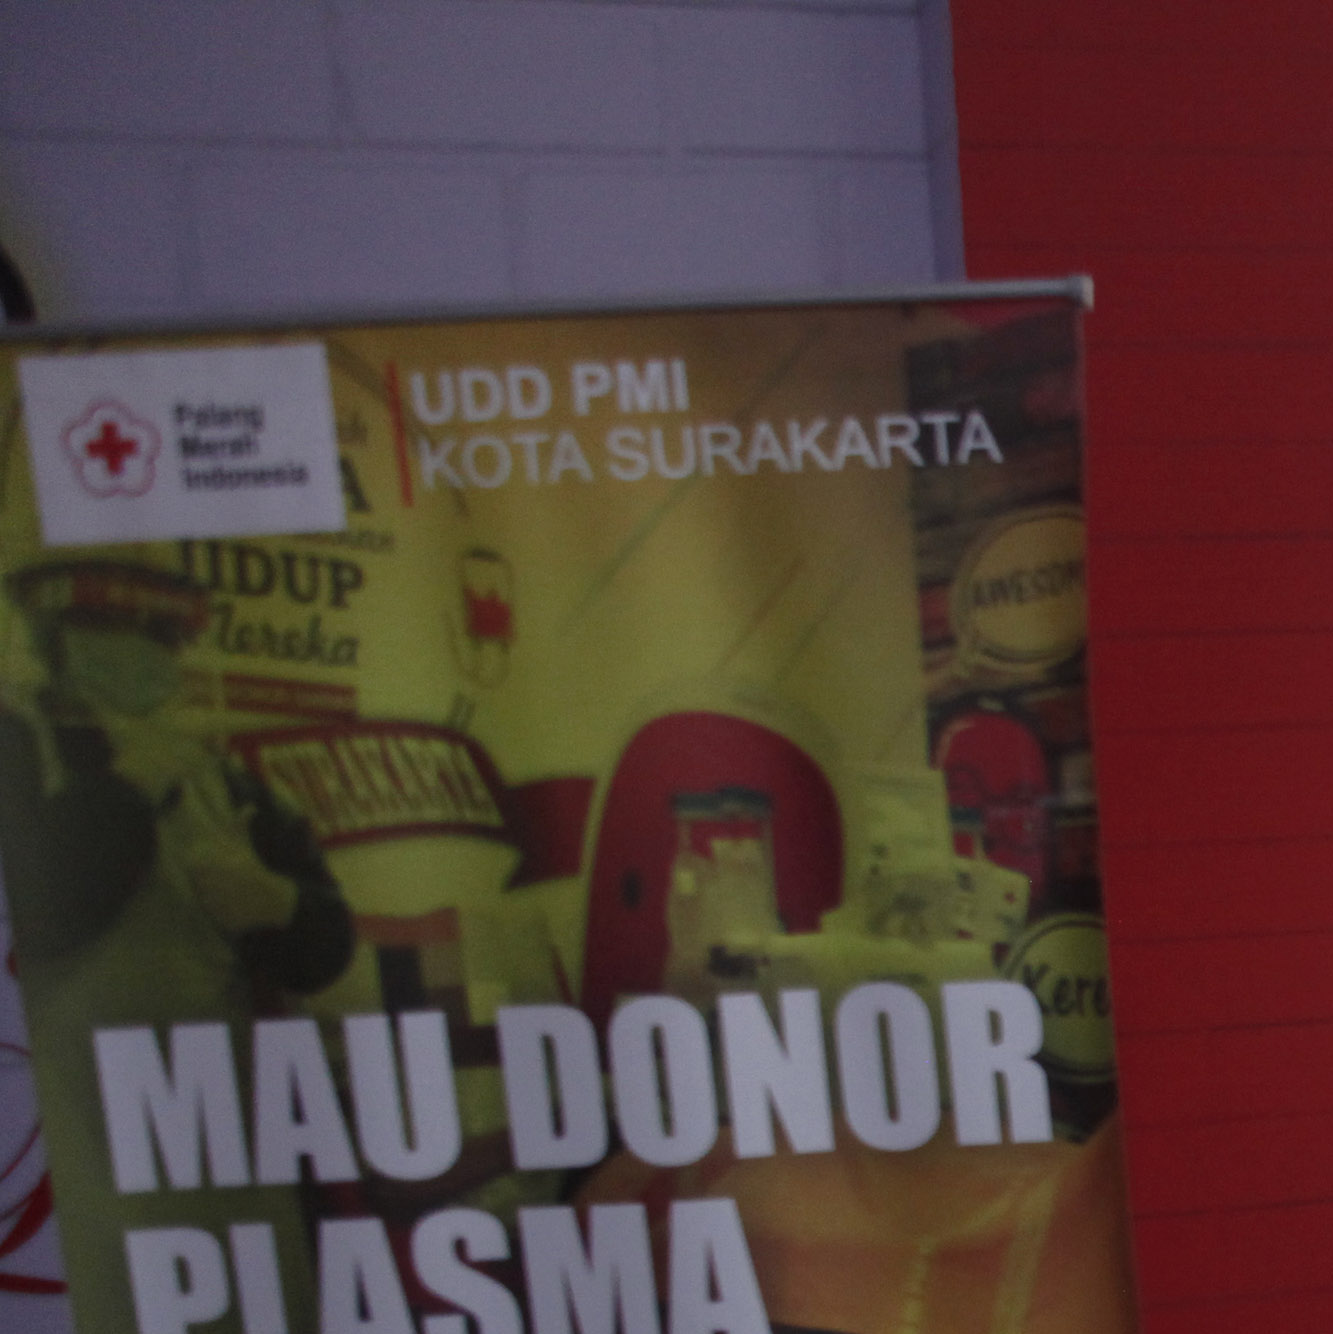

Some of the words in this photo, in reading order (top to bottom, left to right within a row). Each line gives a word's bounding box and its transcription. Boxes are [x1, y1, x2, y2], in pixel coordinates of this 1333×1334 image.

[409, 364, 554, 425] UDD
[571, 358, 691, 416] PMI
[413, 431, 594, 492] KOTA
[606, 409, 1005, 481] SURAKARTA
[92, 1010, 464, 1194] MAU
[496, 979, 1055, 1171] DONOR
